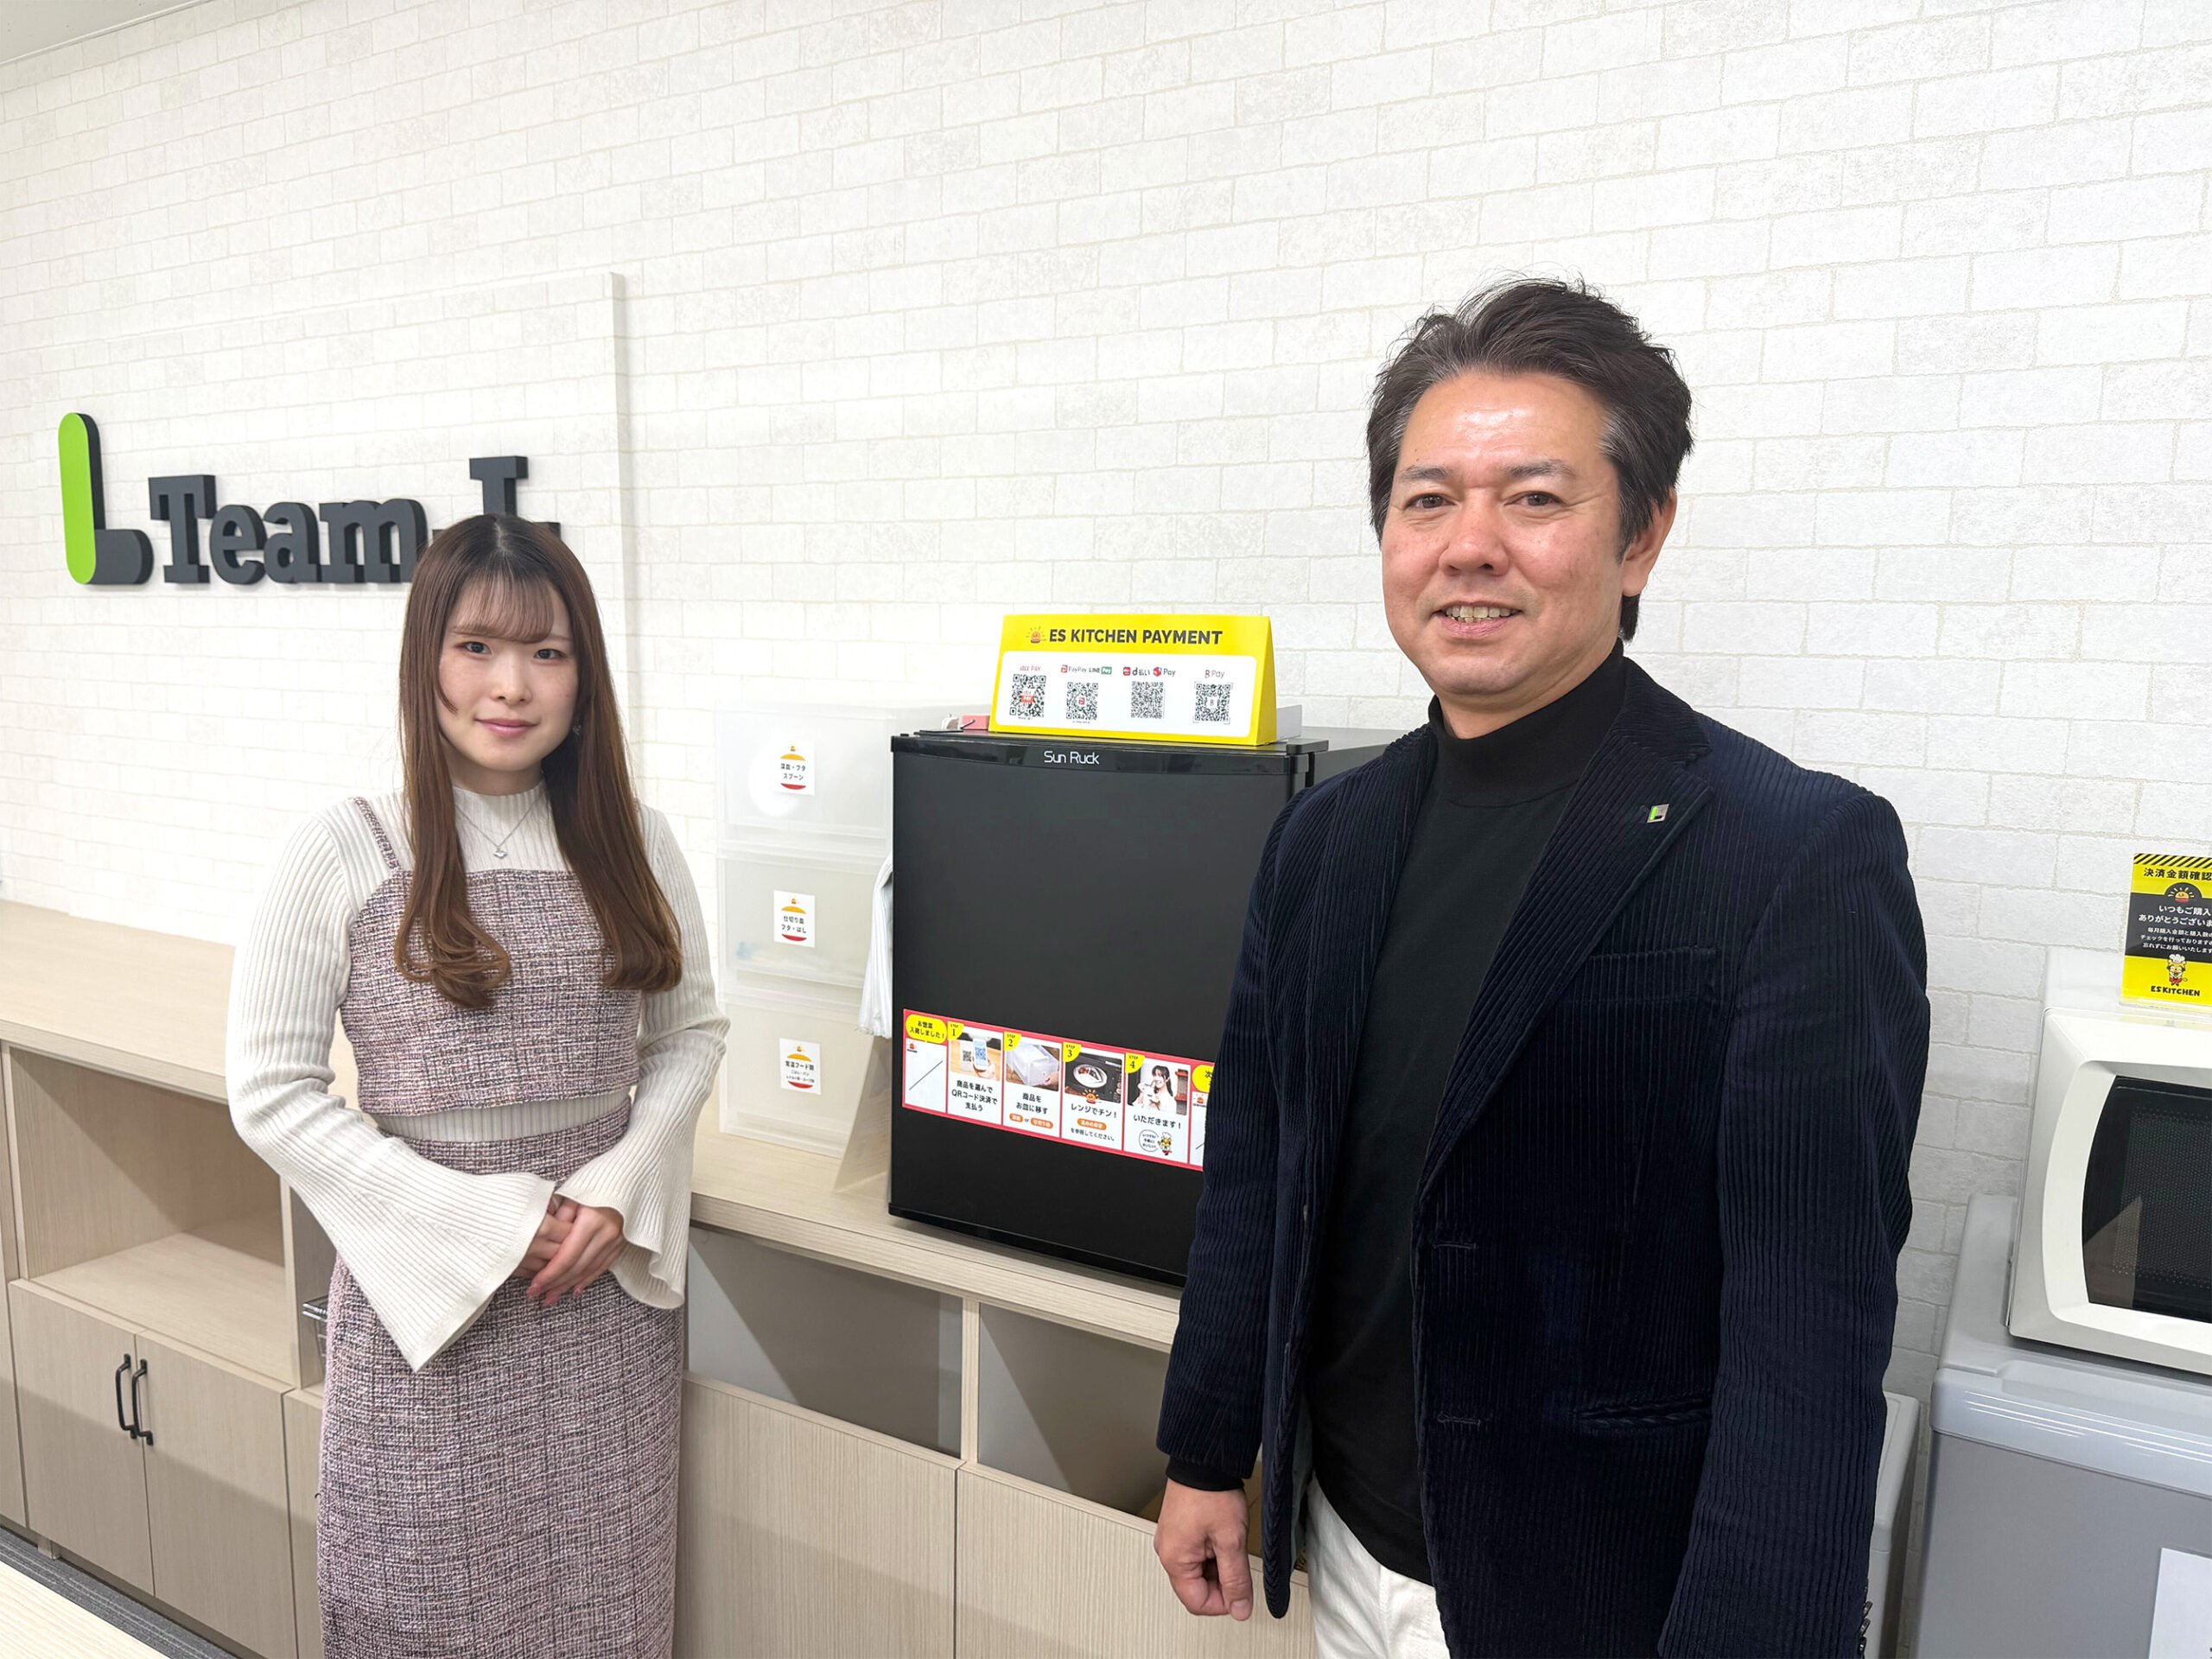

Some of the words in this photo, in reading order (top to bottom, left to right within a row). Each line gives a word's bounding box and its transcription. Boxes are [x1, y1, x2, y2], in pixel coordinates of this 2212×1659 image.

[1049, 628, 1066, 643] ES
[1071, 628, 1137, 644] KITCHEN
[1142, 630, 1223, 645] PAYMENT
[1044, 751, 1067, 764] Sun
[1070, 751, 1100, 765] Ruck
[2162, 986, 2200, 996] KITCHEN
[1008, 1039, 1014, 1047] 2
[1067, 1049, 1073, 1058] 3
[1129, 1060, 1135, 1070] 4
